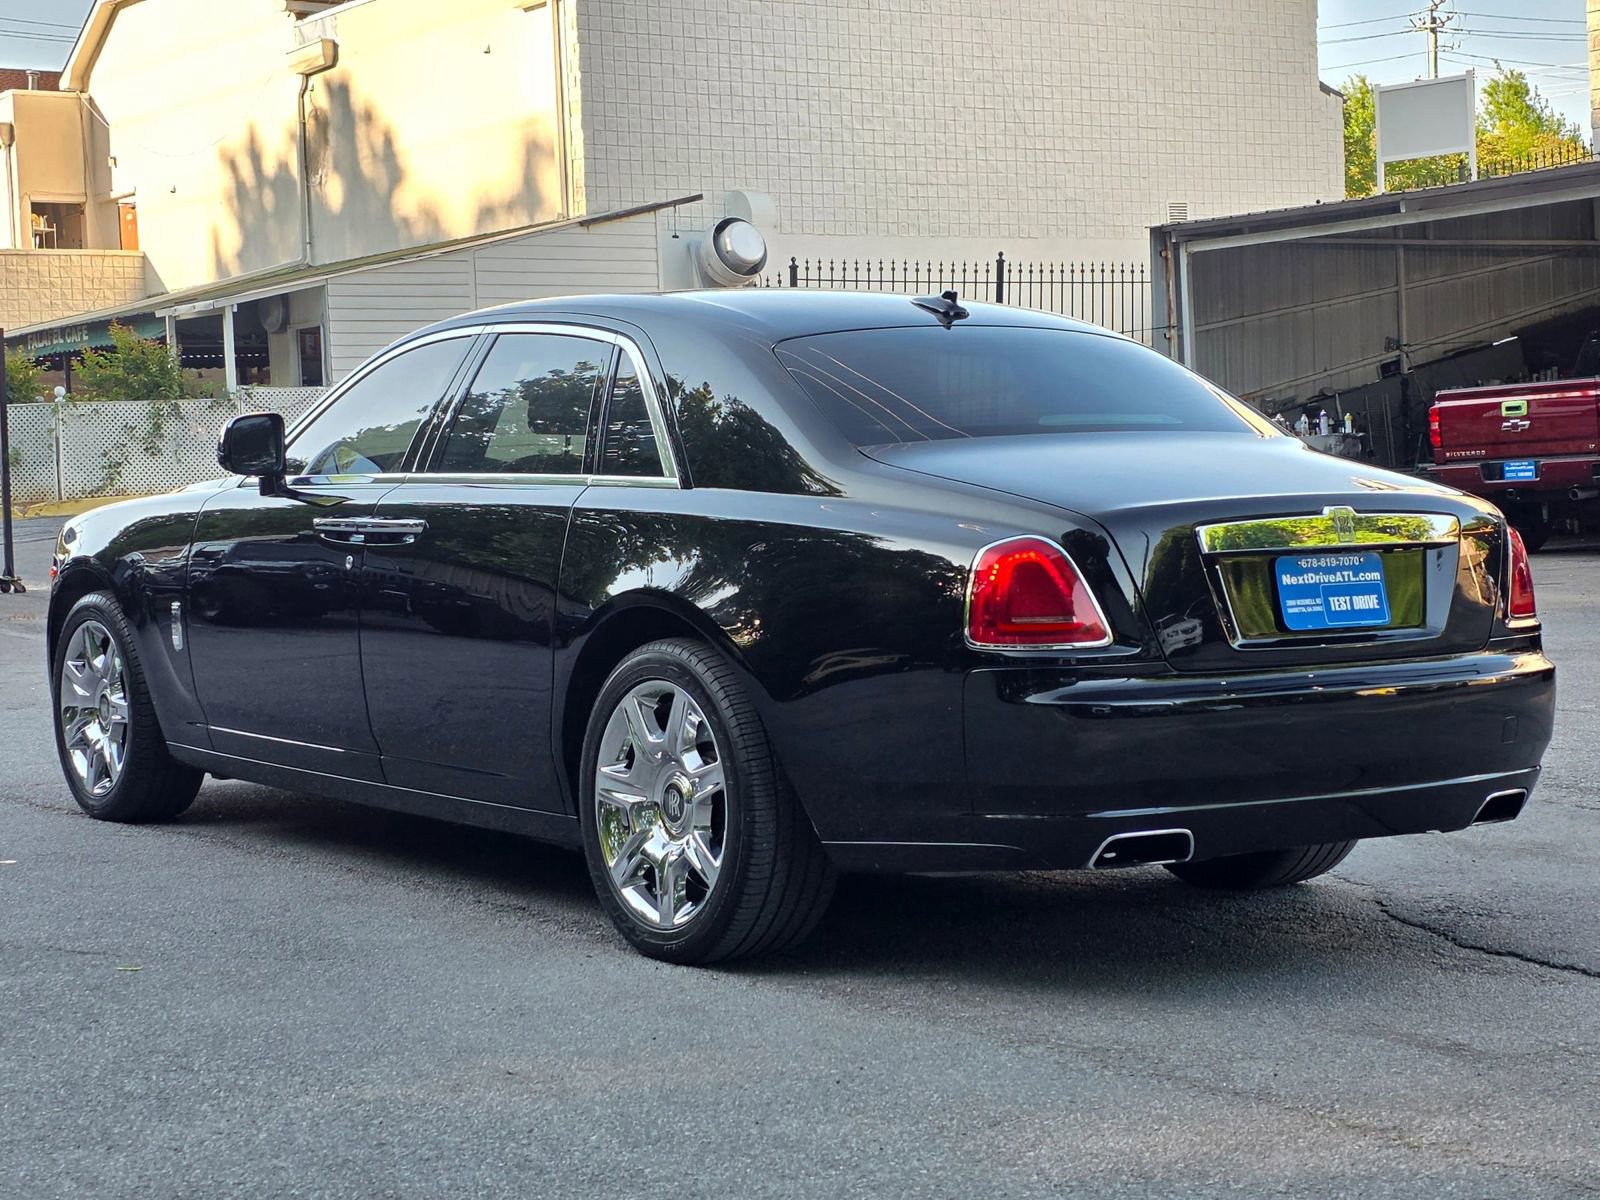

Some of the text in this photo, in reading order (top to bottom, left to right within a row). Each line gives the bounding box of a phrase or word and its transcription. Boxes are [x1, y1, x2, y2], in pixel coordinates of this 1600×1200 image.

[27, 325, 89, 350] FALAFEL CAFE
[1281, 571, 1381, 585] NextDriveATL.com
[1328, 597, 1351, 611] TEST
[1352, 595, 1380, 610] DRIVE
